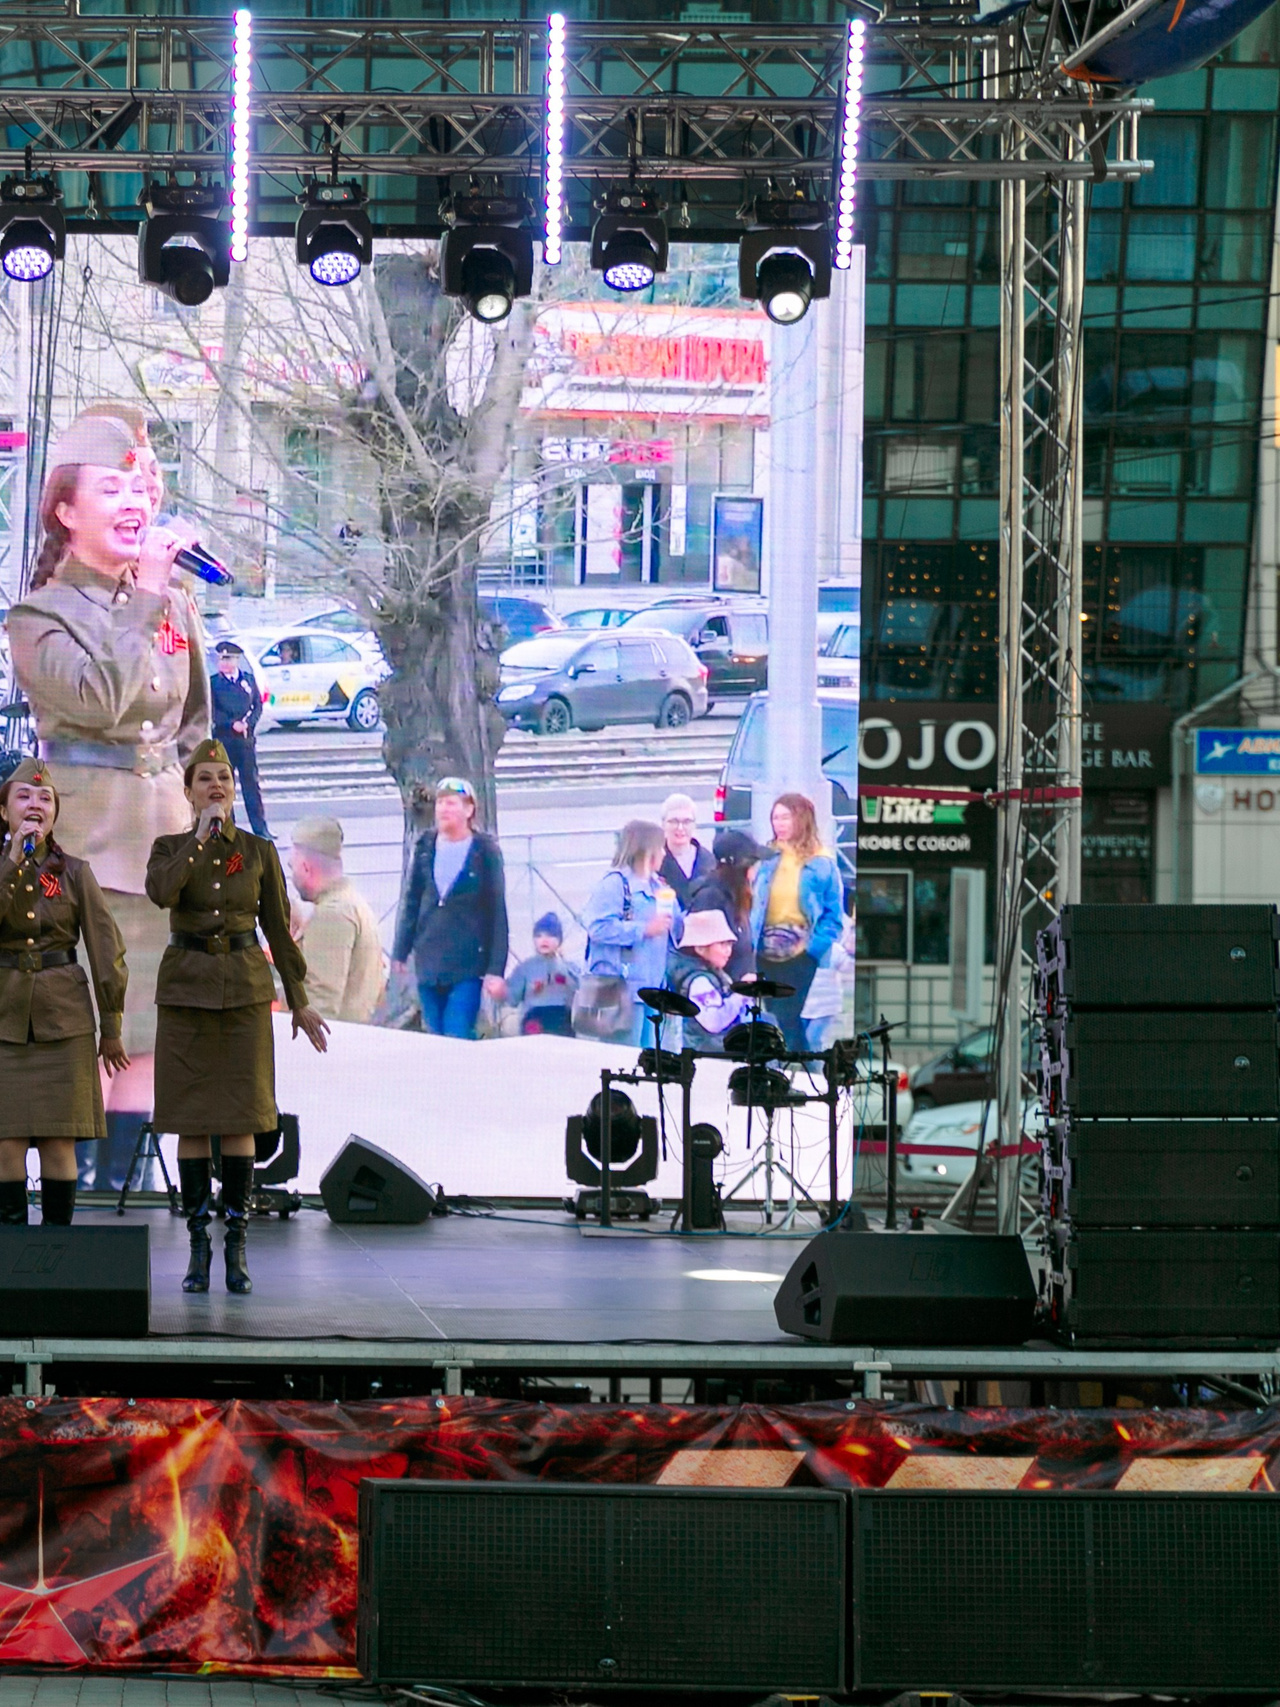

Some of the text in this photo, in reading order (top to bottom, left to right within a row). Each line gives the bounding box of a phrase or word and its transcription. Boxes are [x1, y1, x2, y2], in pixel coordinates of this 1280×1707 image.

[1112, 749, 1153, 768] BAR
[1234, 789, 1280, 811] HO
[882, 805, 934, 824] LIKE
[858, 835, 902, 851] КОФЕ
[917, 834, 970, 851] СОБОЙ
